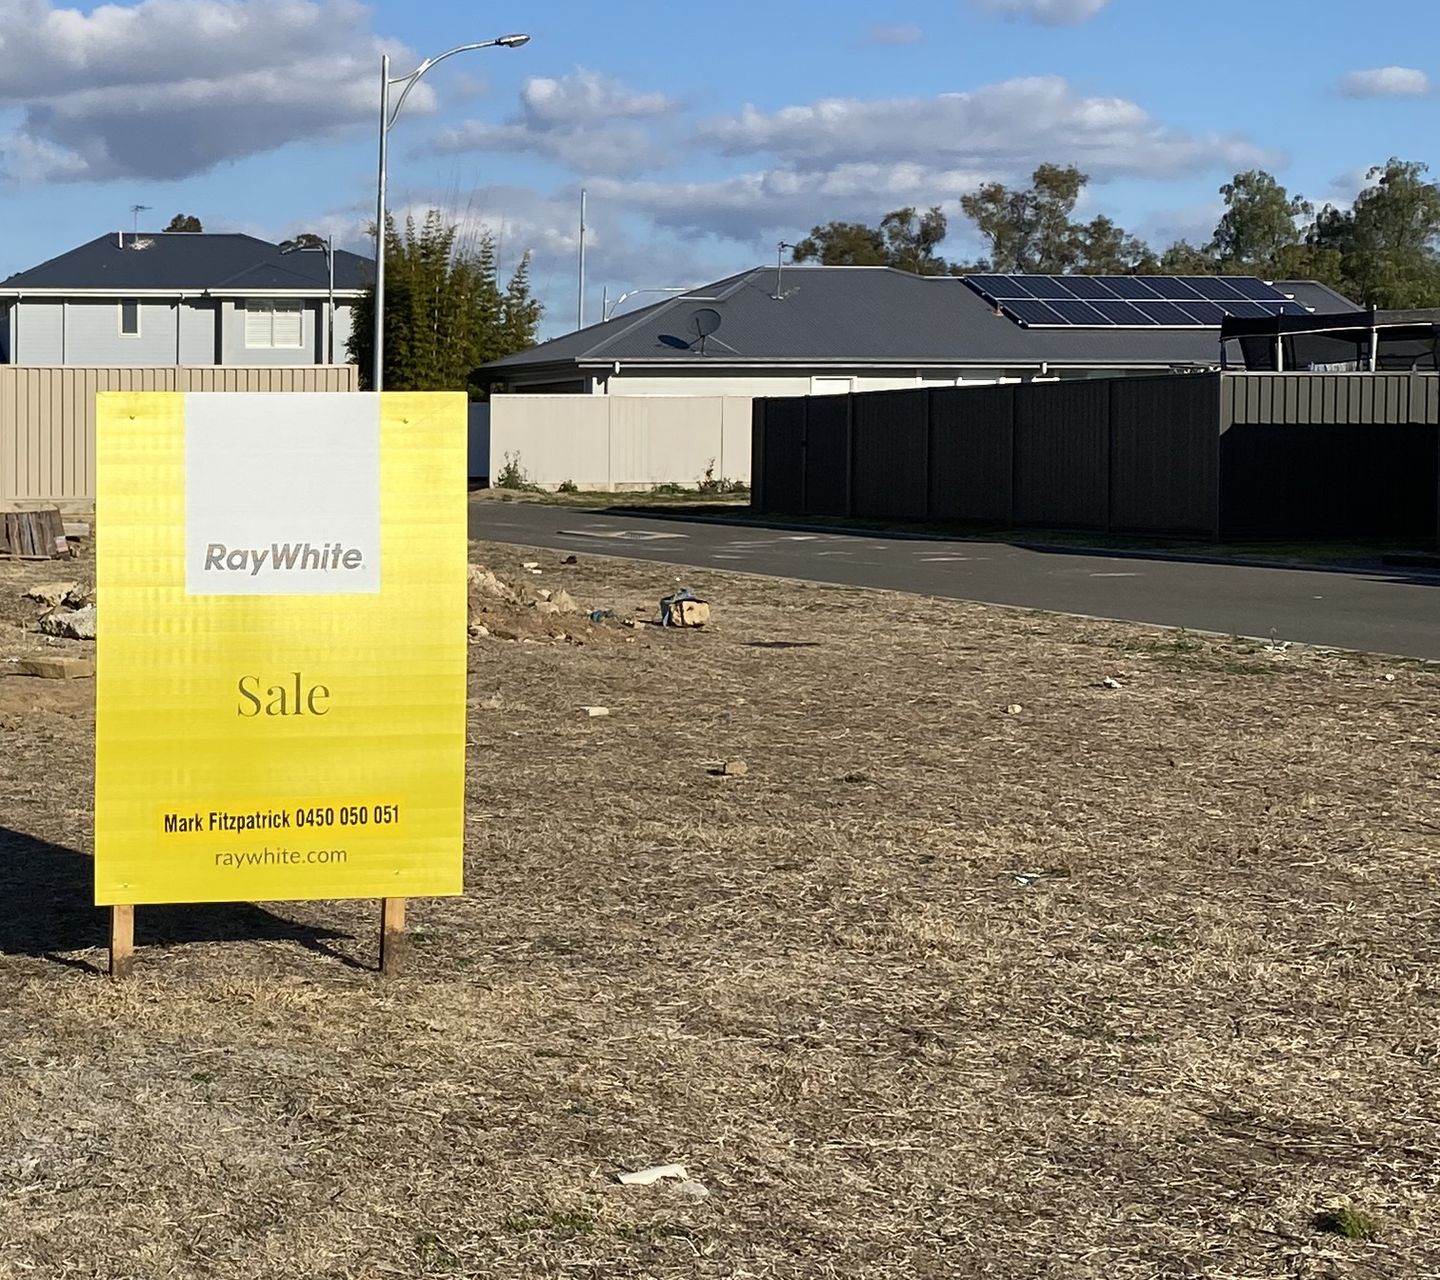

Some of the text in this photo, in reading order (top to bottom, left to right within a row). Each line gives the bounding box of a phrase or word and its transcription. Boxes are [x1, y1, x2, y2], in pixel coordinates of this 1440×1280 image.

[237, 671, 330, 718] Sale
[164, 804, 399, 834] Mark Fitzpatrick 0450 050 051
[215, 847, 348, 869] raywhite.com
